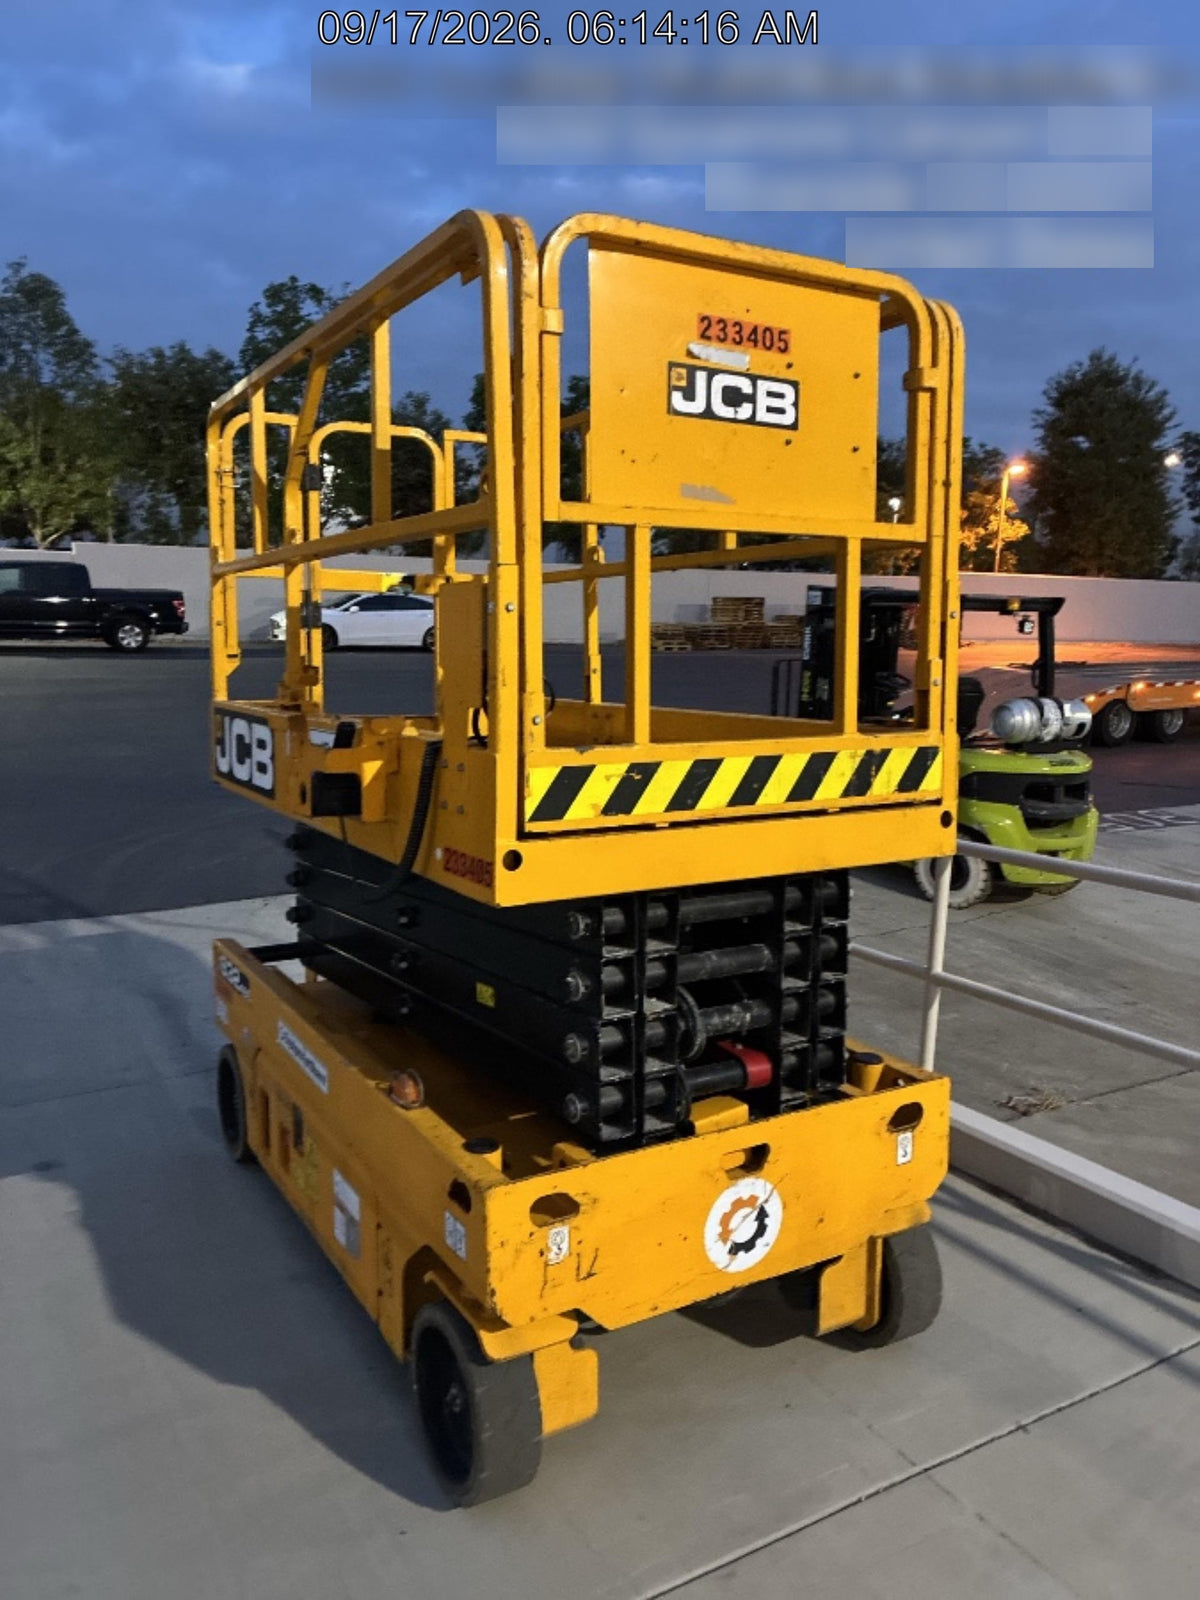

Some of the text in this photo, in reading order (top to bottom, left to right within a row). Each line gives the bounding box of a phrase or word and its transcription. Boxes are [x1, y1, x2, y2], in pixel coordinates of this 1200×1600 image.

[700, 315, 789, 354] 233405
[671, 370, 796, 426] JCB
[215, 715, 273, 790] JCB
